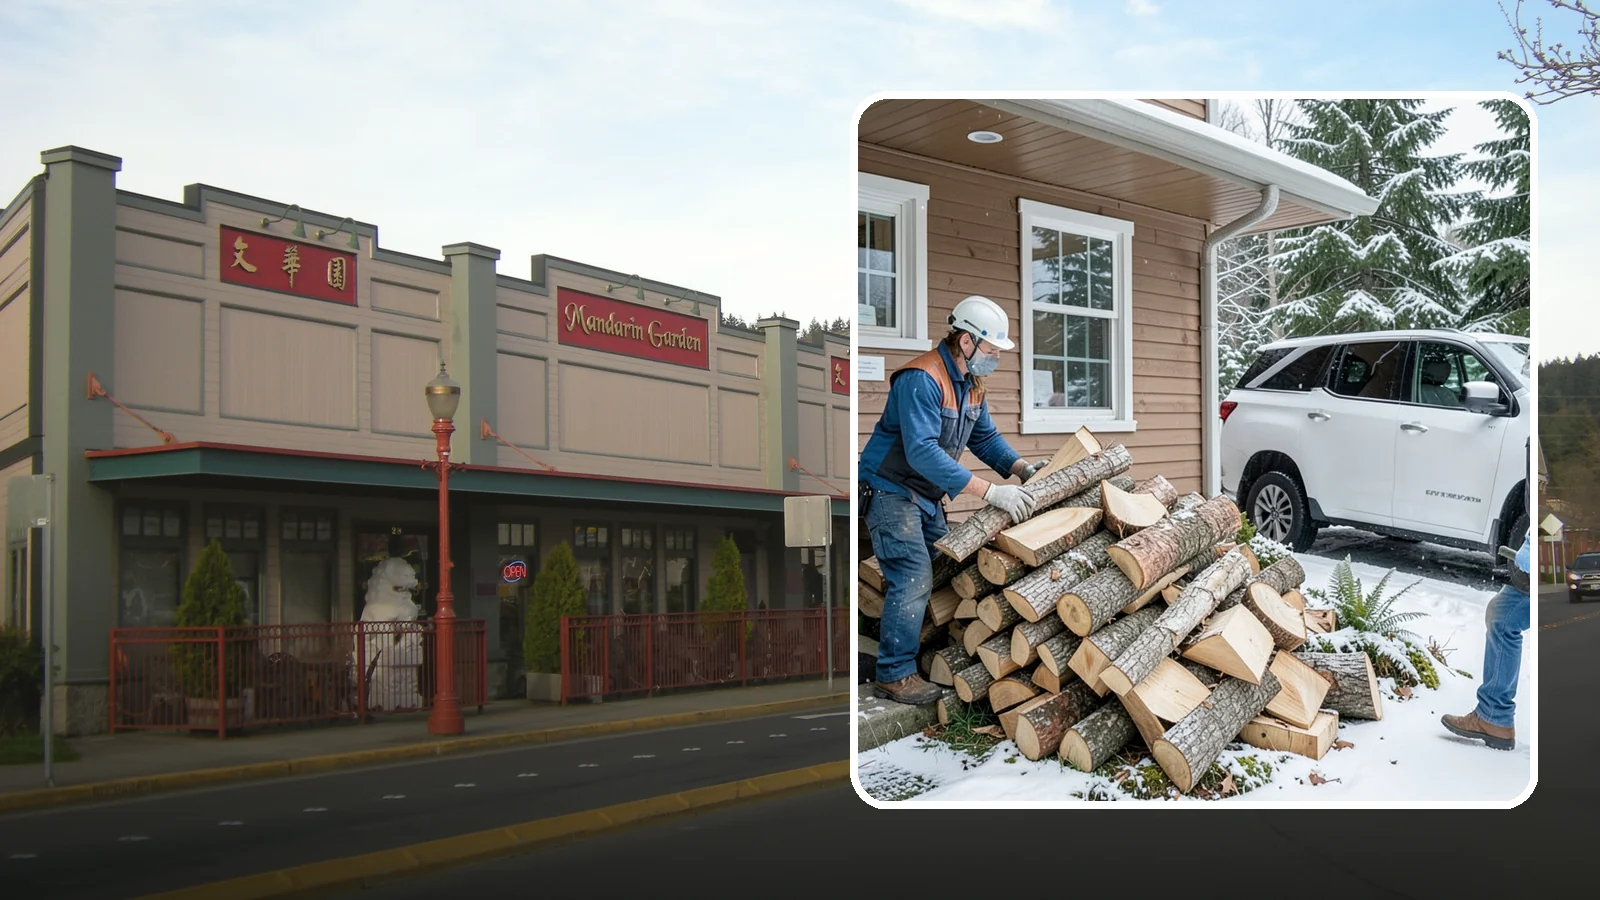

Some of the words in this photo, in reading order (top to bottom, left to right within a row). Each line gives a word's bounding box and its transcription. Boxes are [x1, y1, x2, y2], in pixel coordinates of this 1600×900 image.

[230, 235, 346, 291] 文華園
[564, 302, 644, 341] Mandarin
[648, 320, 702, 352] Garden
[503, 565, 527, 578] OPEN
